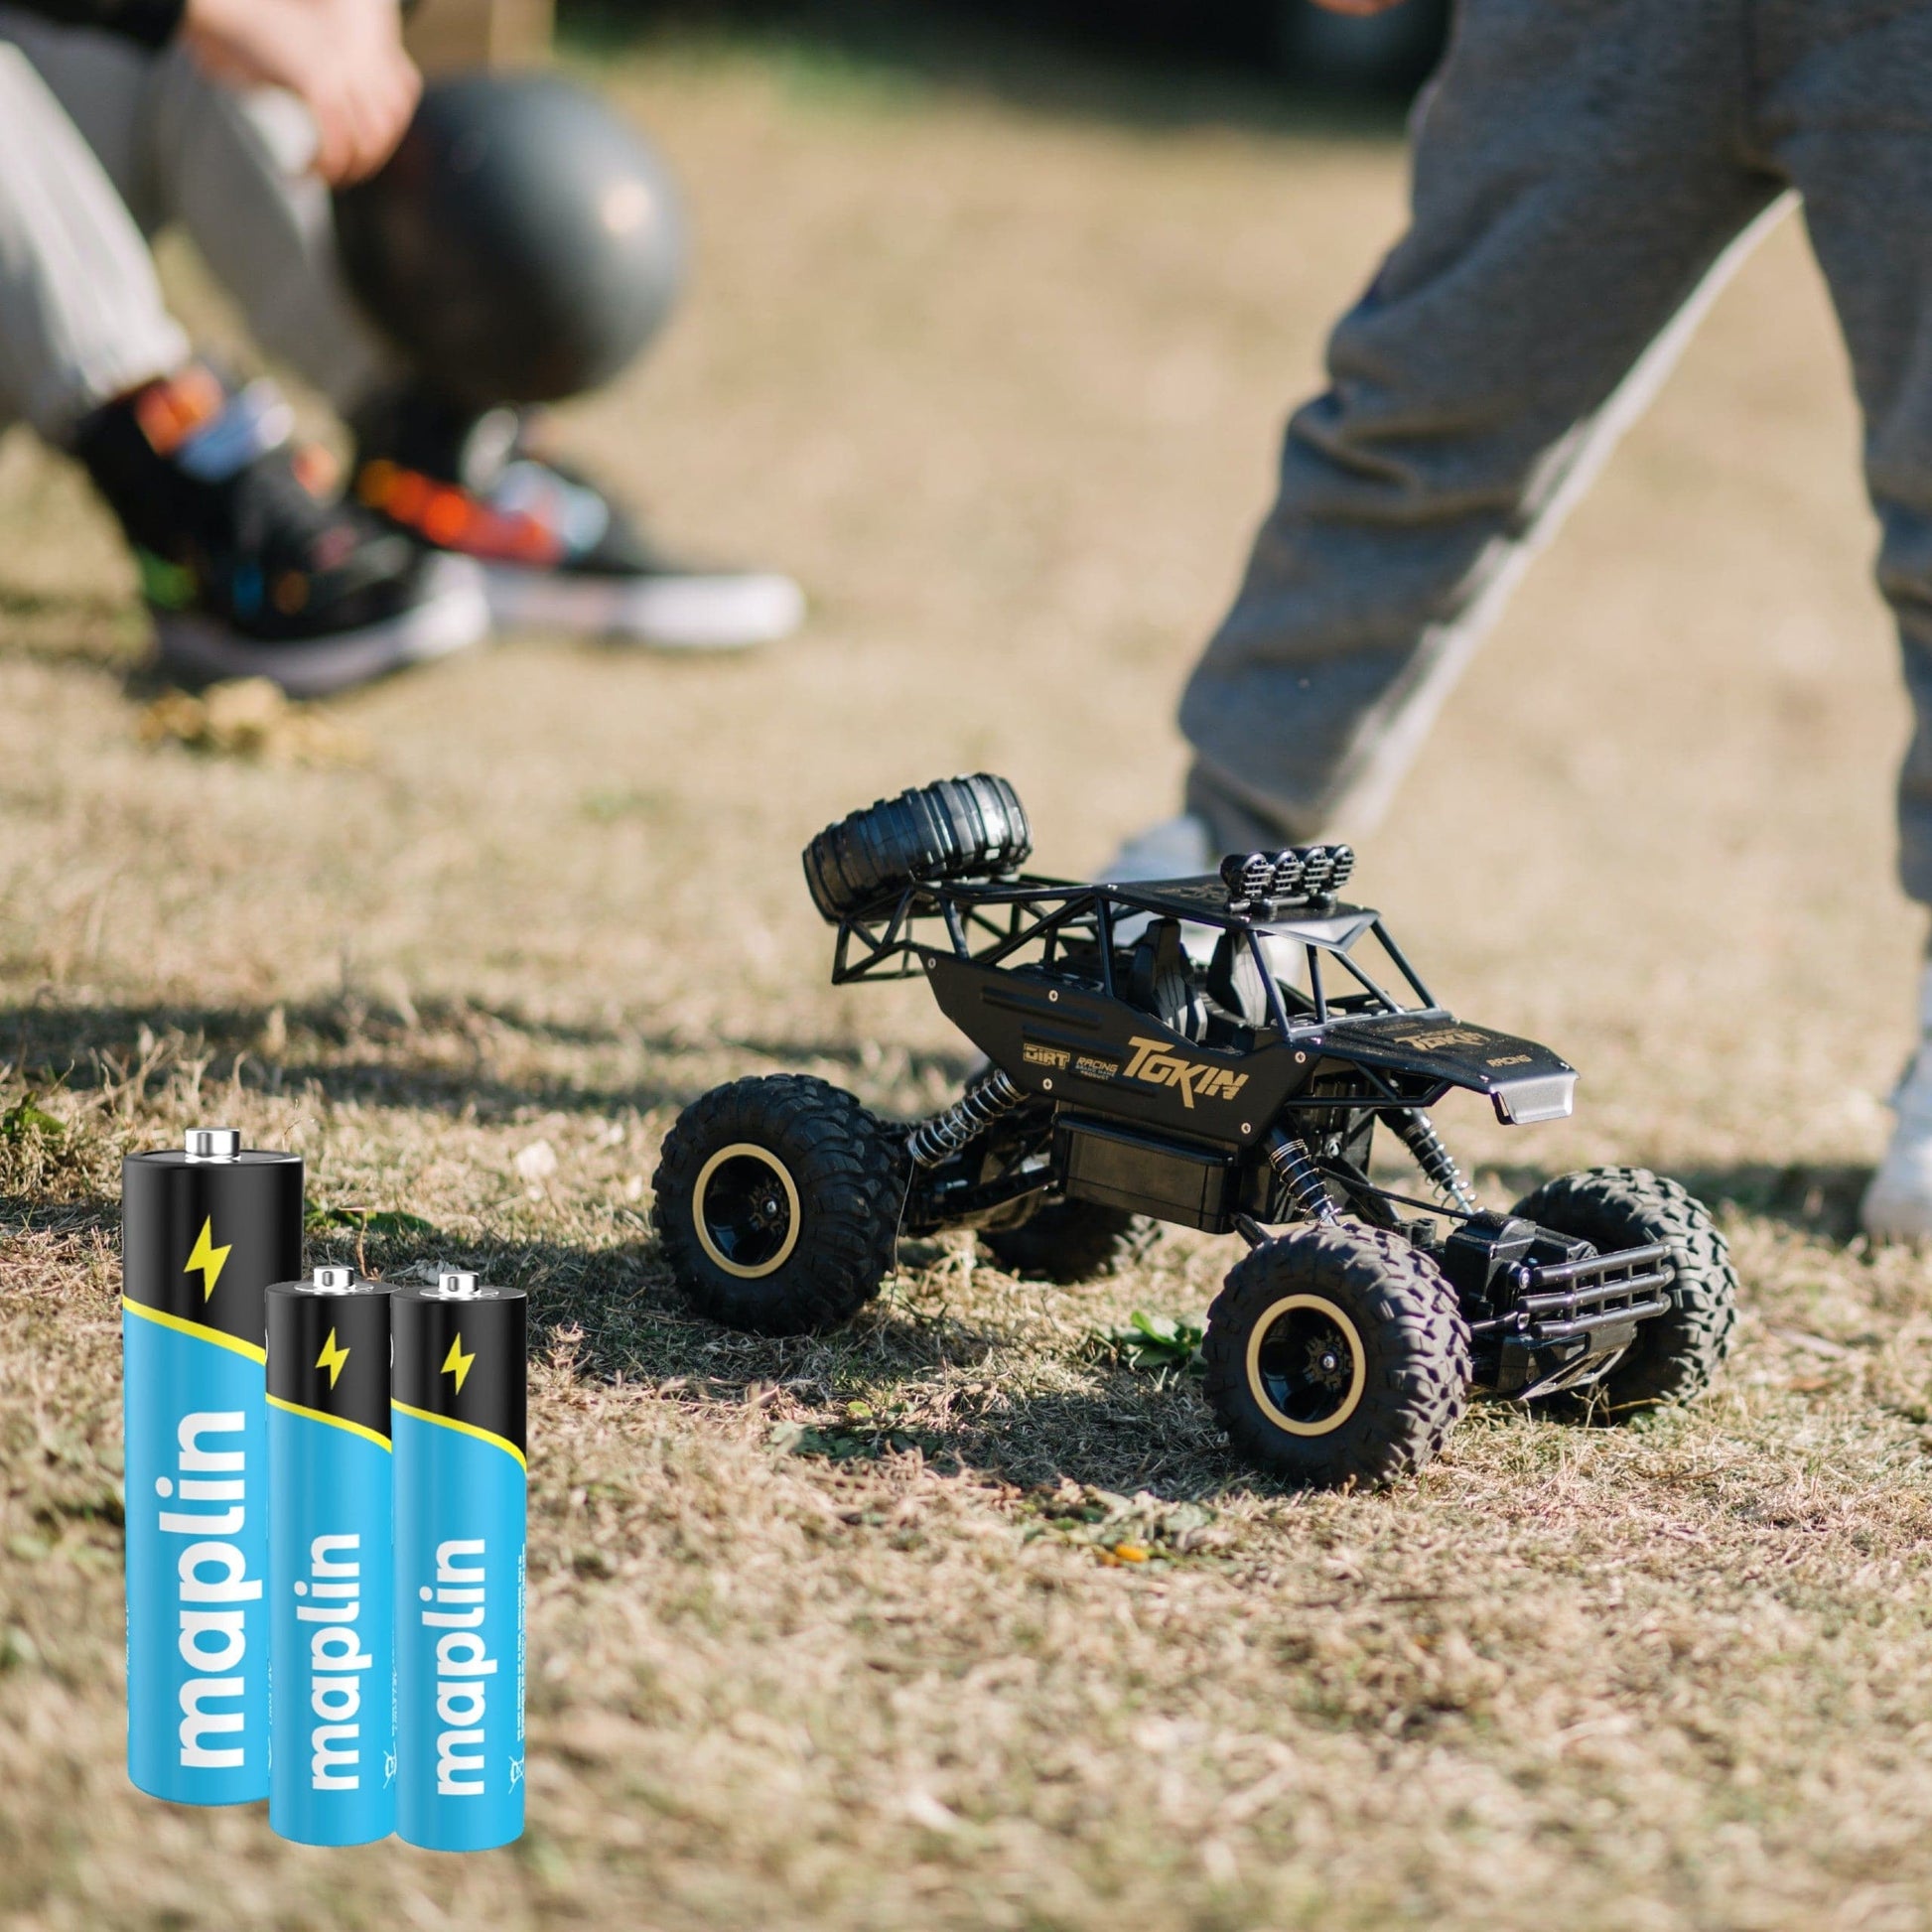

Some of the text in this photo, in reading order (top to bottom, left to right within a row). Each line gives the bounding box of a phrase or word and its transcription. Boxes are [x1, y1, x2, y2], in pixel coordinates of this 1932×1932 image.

[1077, 1056, 1119, 1073] RACING
[155, 1411, 263, 1767] maplin
[294, 1534, 372, 1790] maplin
[419, 1539, 497, 1795] maplin
